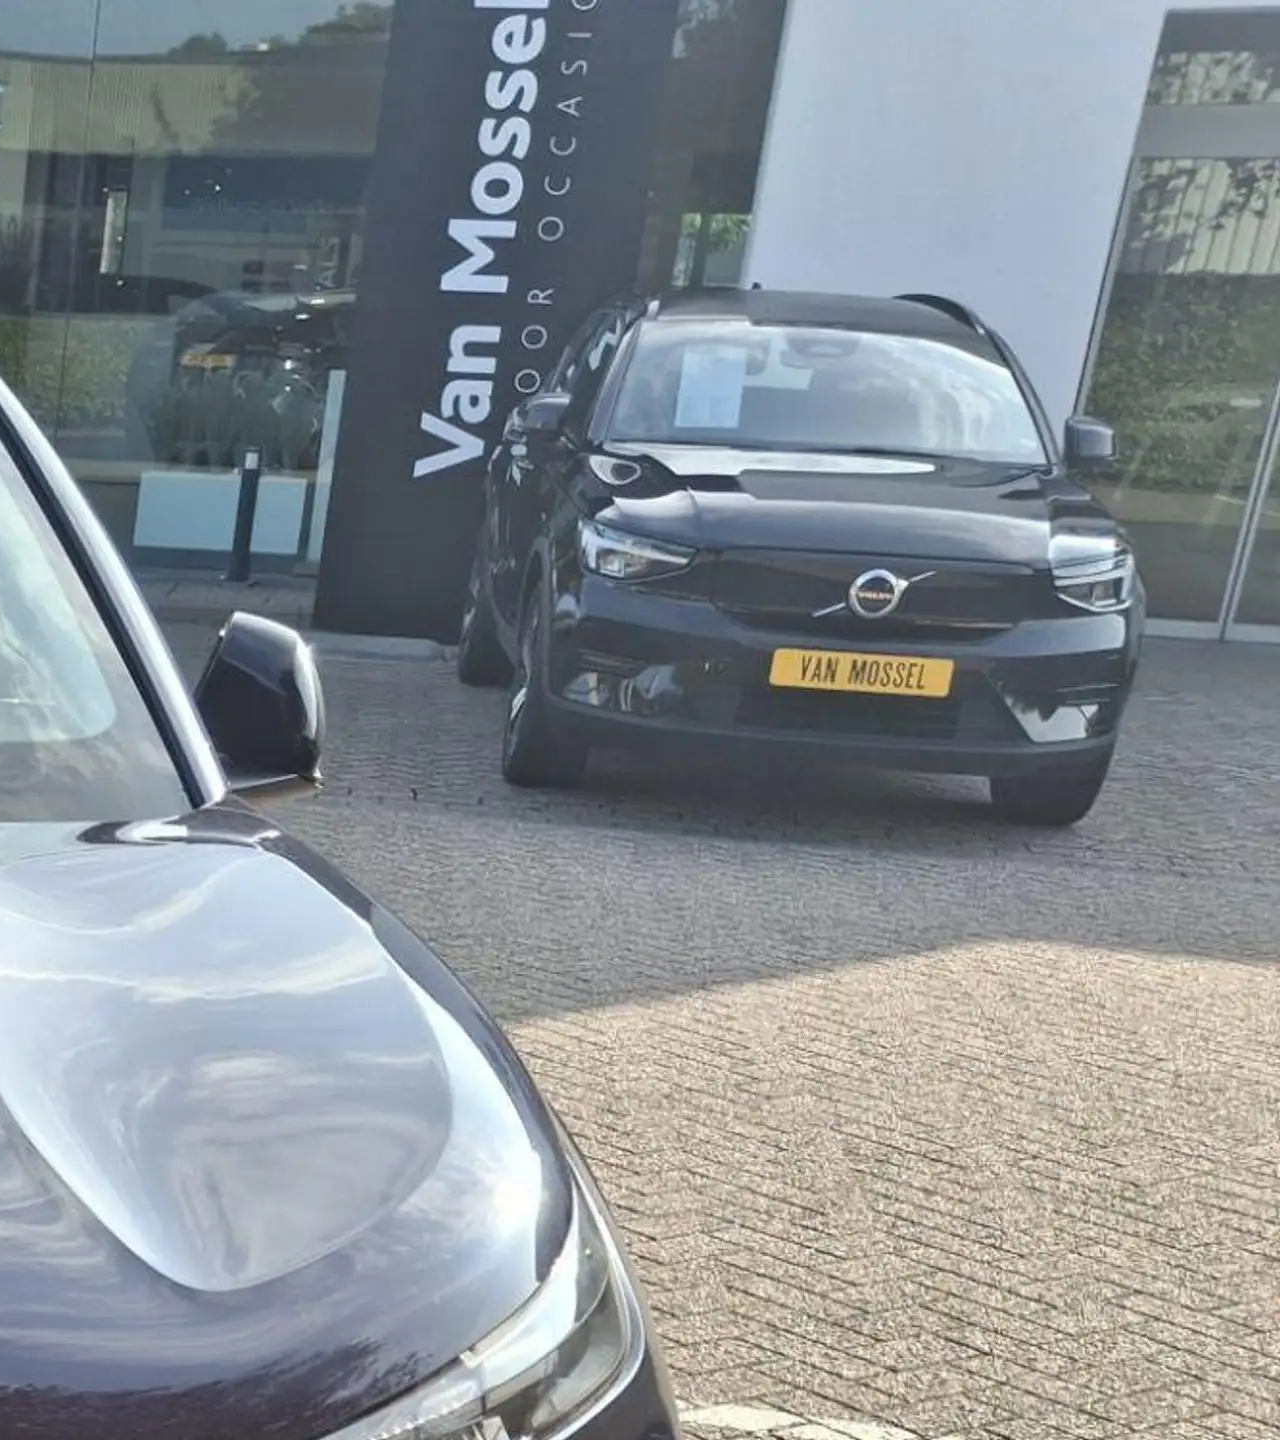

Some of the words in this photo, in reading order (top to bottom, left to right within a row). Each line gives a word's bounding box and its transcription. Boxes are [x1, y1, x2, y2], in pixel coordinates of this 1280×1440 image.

[515, 288, 555, 392] OOR
[413, 325, 501, 477] Van
[800, 655, 839, 683] VAN
[848, 658, 926, 690] MOSSEL
